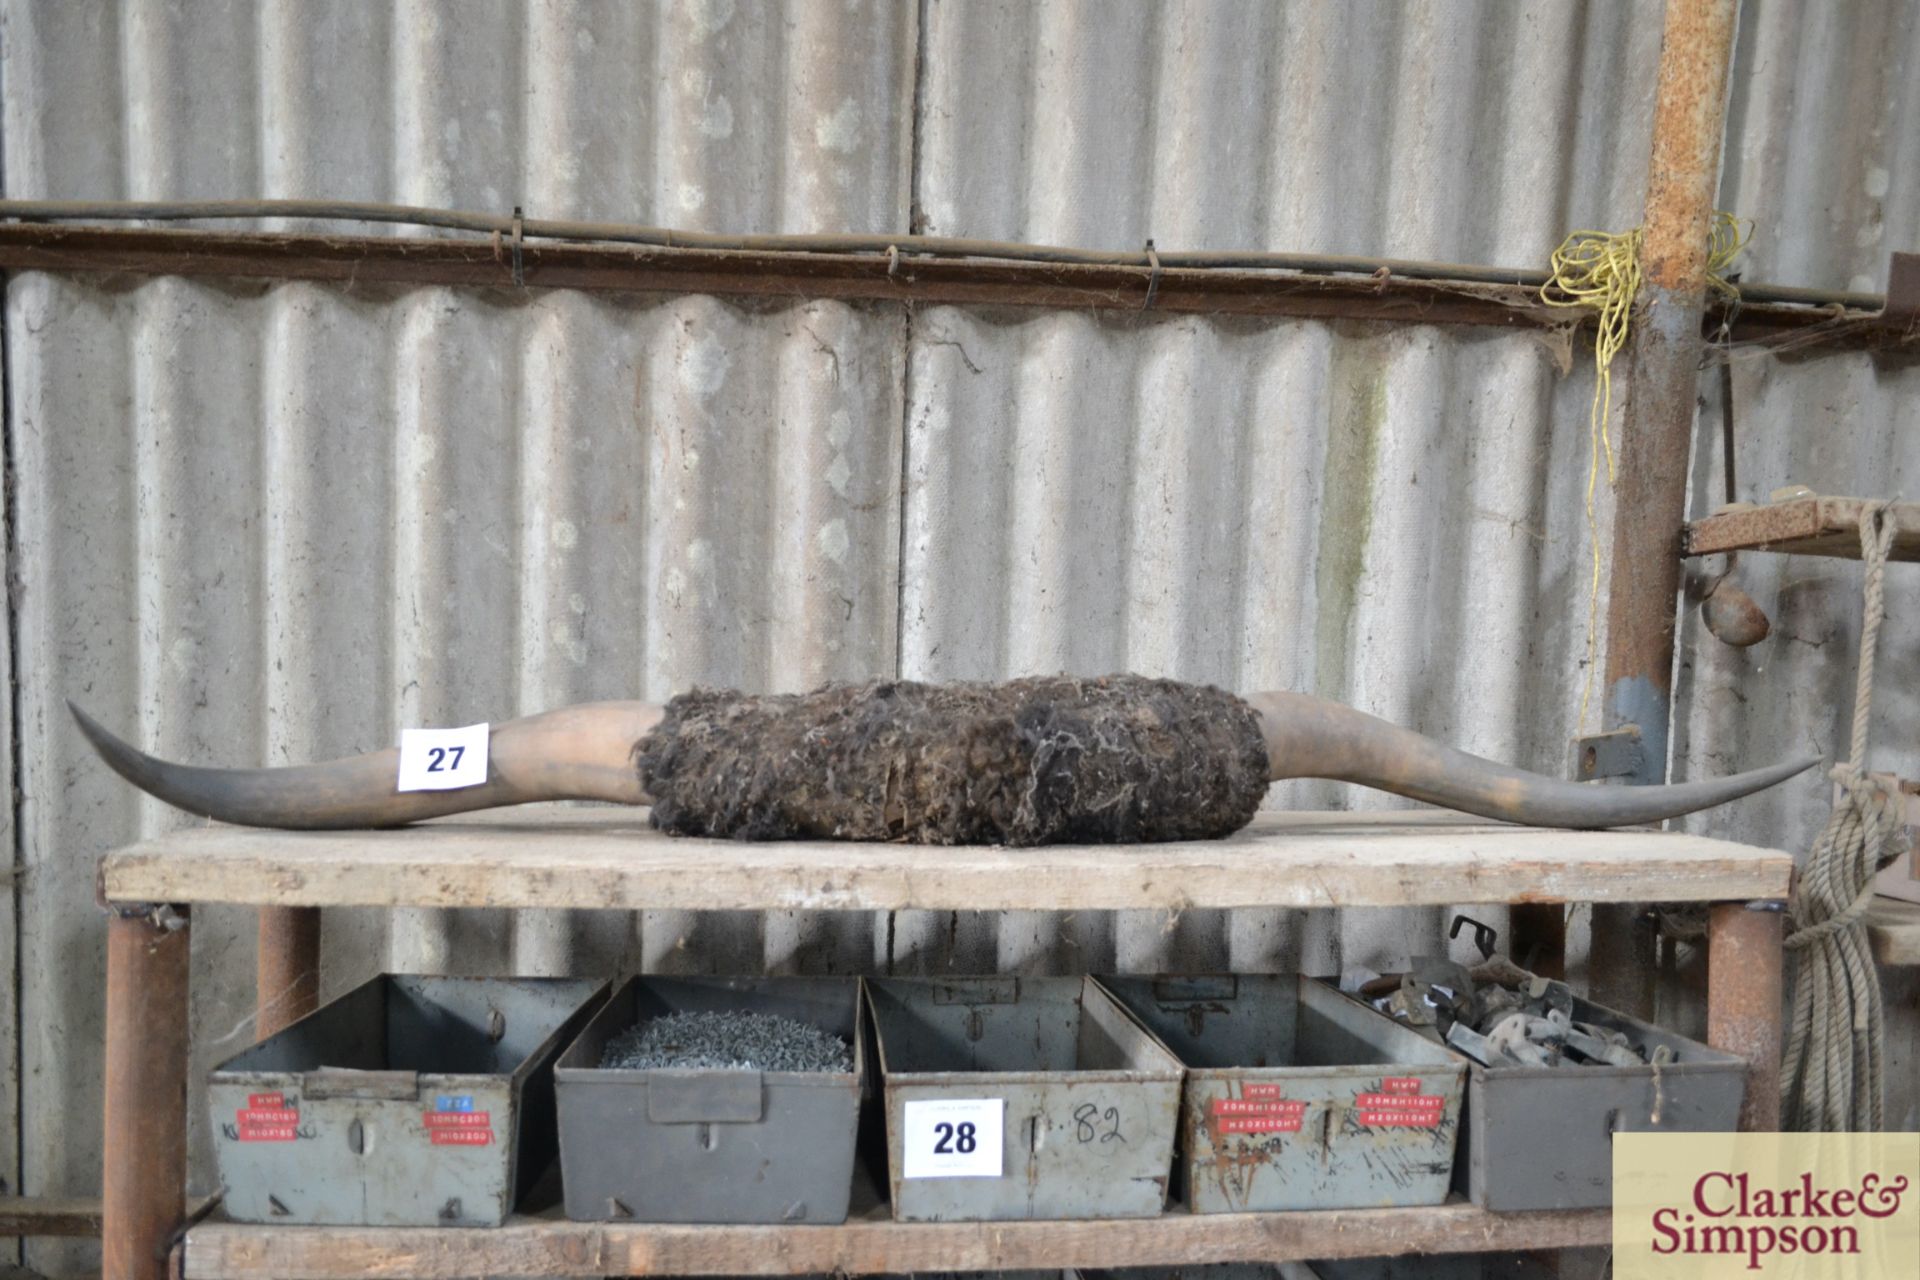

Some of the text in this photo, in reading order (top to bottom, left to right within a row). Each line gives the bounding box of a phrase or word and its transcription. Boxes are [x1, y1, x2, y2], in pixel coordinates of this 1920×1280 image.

[427, 745, 466, 773] 27
[933, 1121, 977, 1154] 28
[1073, 1102, 1128, 1145] 82
